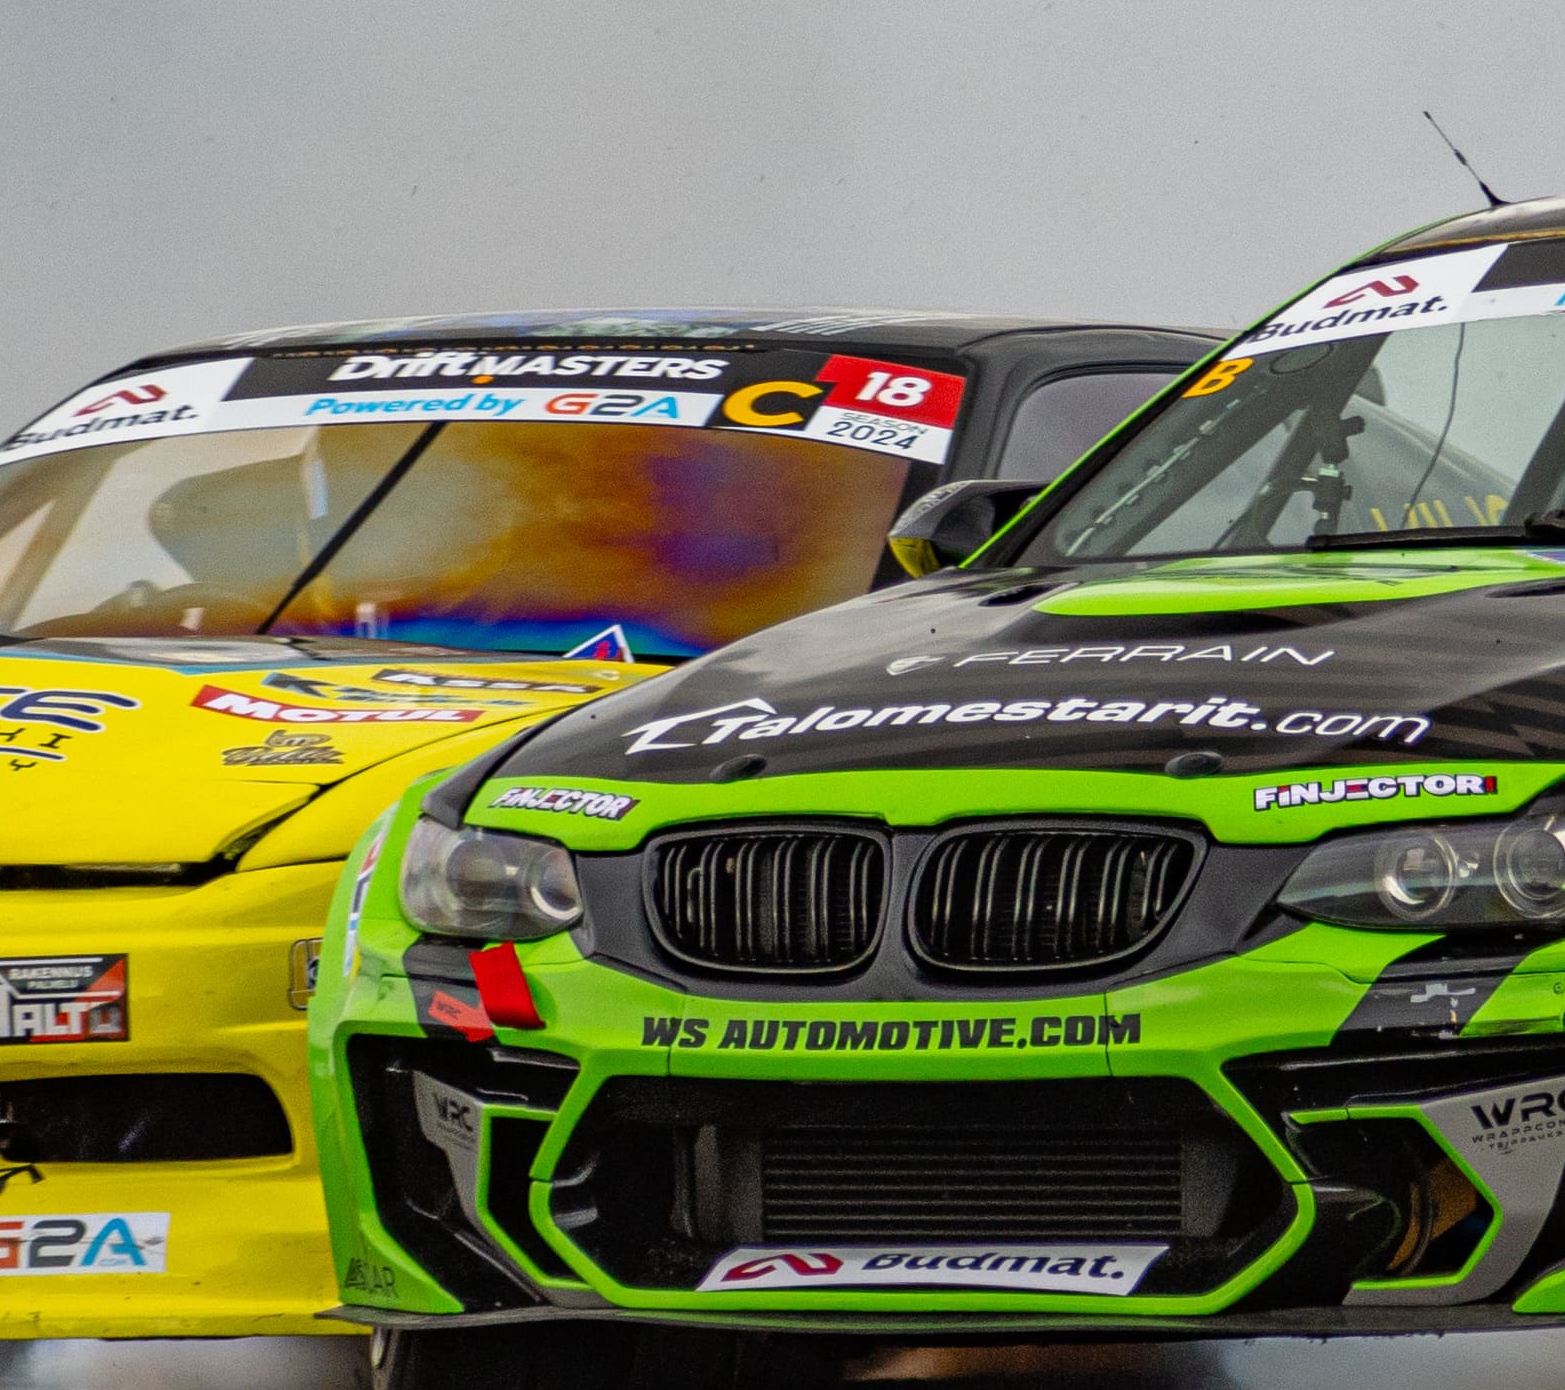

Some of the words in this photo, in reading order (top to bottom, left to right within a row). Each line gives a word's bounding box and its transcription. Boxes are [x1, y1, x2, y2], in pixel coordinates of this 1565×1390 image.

[853, 370, 933, 407] 18
[1180, 357, 1254, 398] B
[305, 393, 474, 417] Powered
[475, 392, 527, 417] by
[544, 393, 679, 419] G2A
[722, 380, 823, 428] C
[826, 420, 919, 451] 2024
[949, 644, 1335, 671] FERRAIN
[209, 692, 464, 723] MOTUL
[704, 695, 1431, 746] Talomestarit.com
[641, 1016, 710, 1048] WS
[717, 1013, 1142, 1051] AUTOMOTIVE.COM
[860, 1251, 1126, 1280] Budmat.
